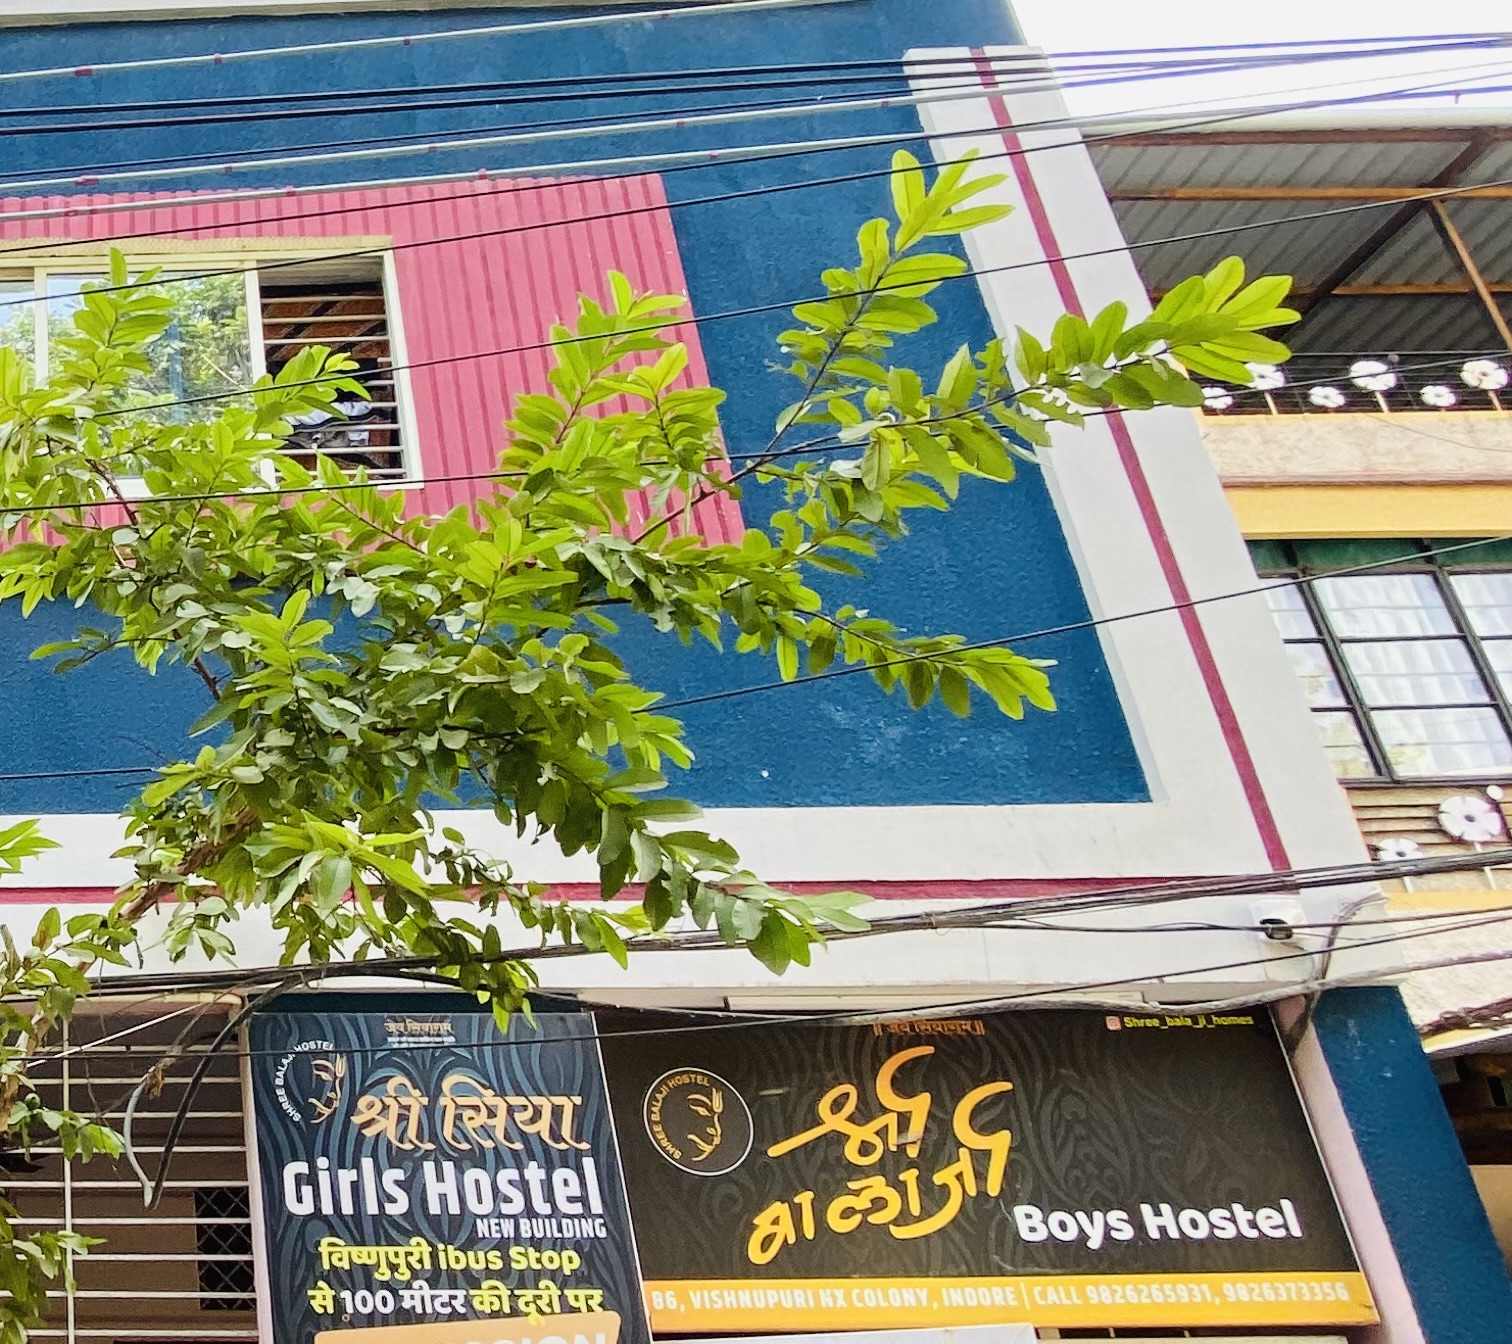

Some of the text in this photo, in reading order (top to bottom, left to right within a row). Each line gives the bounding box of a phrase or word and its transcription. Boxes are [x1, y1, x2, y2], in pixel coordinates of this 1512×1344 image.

[650, 1074, 710, 1159] SHREE BALAJI HOSTEL
[283, 1156, 604, 1216] Girls Hostel
[476, 1218, 607, 1238] NEW BUILDING
[1013, 1198, 1303, 1250] Boys Hostel
[318, 1236, 582, 1281] विष्णुपुरी ibus Stop
[307, 1279, 604, 1326] से 100 मीटर की दूरी पर
[689, 1288, 814, 1311] VISHNUPURI
[941, 1286, 1017, 1307] INDORE
[1034, 1285, 1082, 1306] CALL
